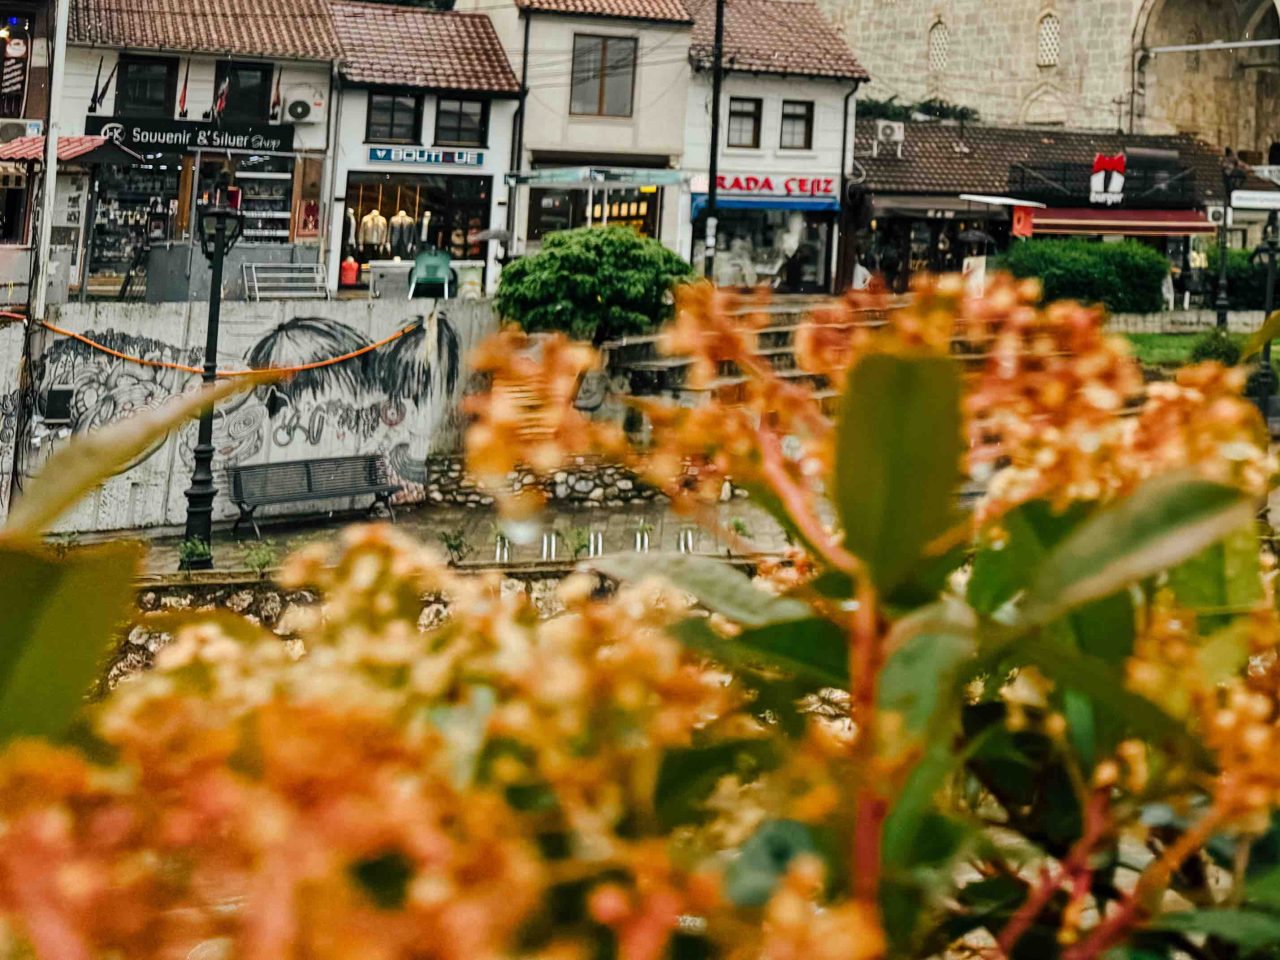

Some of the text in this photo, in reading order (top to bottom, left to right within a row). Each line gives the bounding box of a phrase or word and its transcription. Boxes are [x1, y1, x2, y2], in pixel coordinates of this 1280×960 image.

[132, 127, 191, 145] Souvenir
[199, 131, 208, 146] &
[212, 132, 248, 148] Silver
